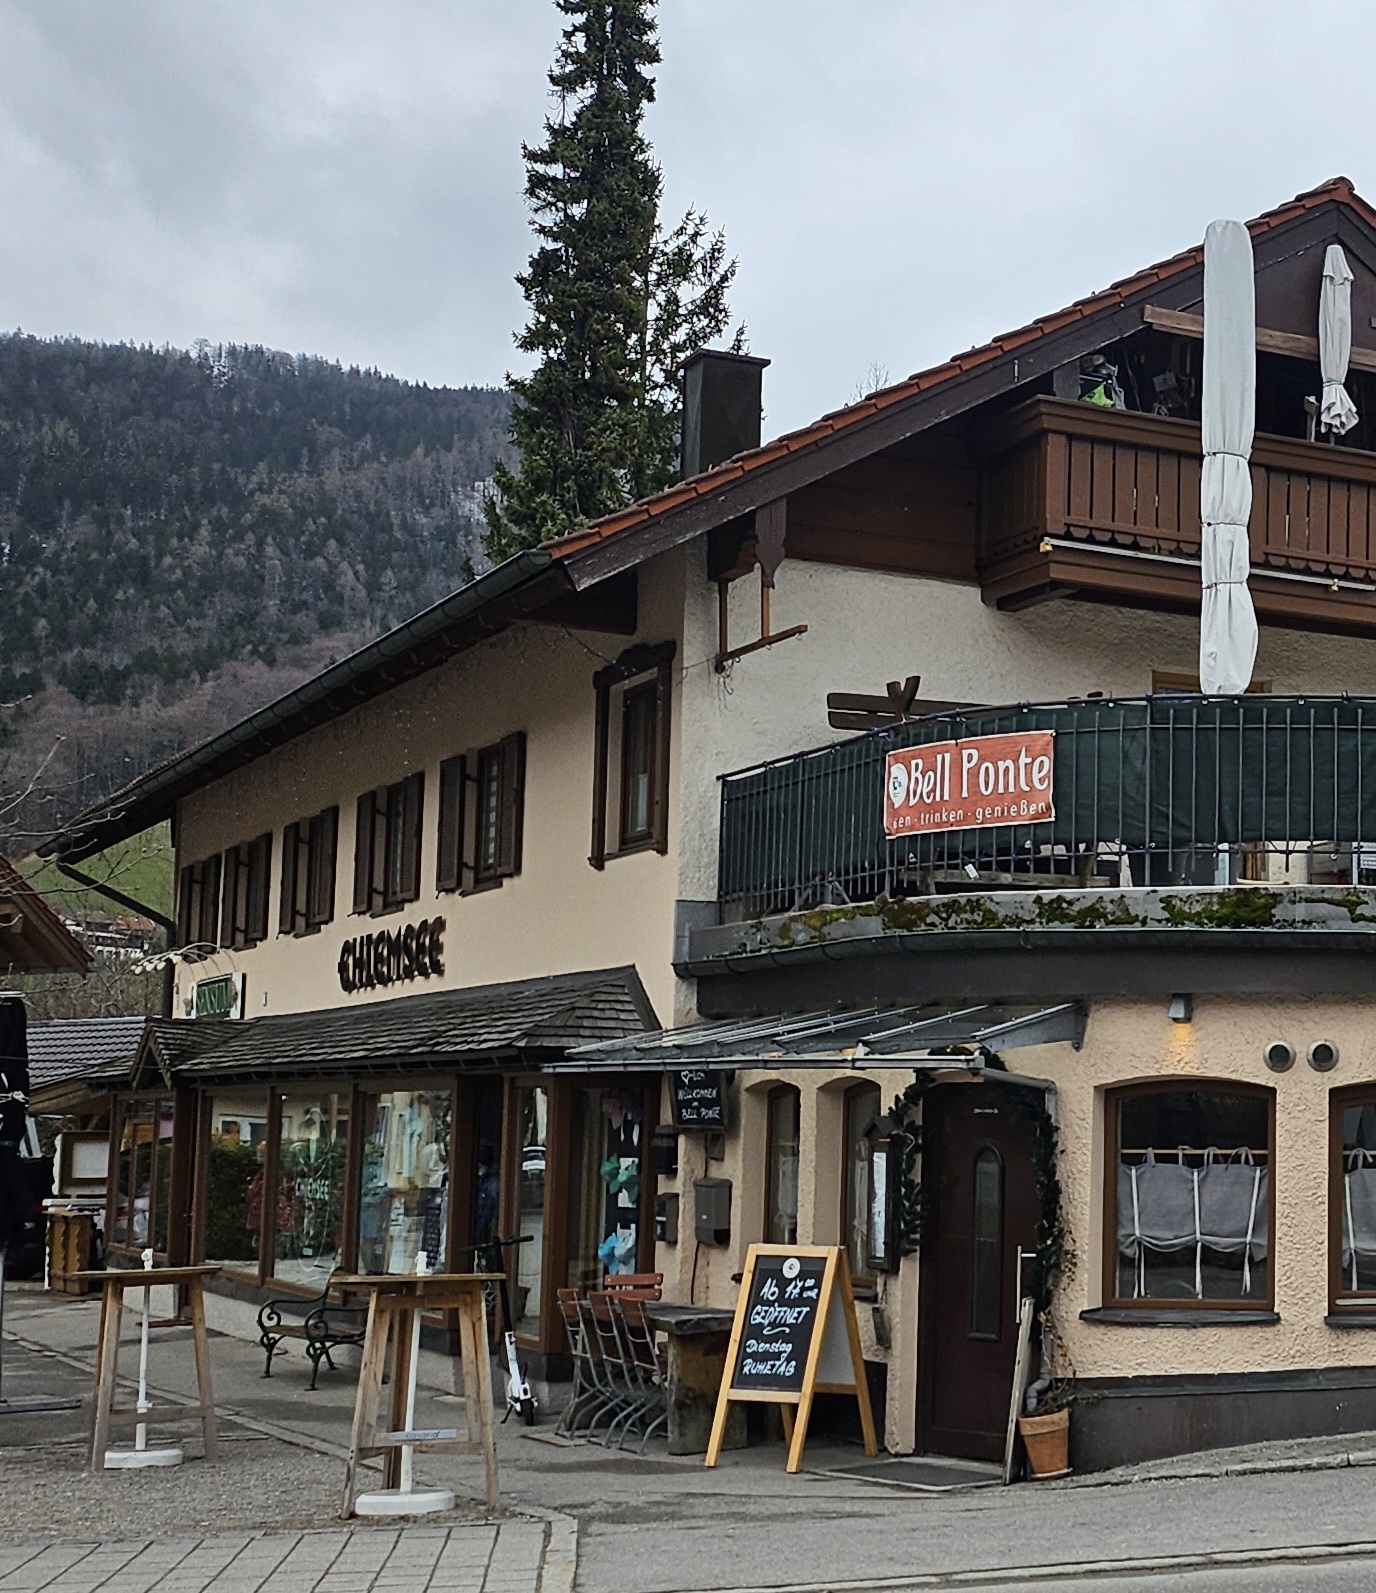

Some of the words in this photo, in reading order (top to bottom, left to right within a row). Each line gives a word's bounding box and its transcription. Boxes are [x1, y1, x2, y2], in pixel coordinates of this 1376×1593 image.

[908, 752, 951, 807] Bell
[961, 746, 1051, 798] Ponte
[920, 807, 964, 826] trinken
[975, 799, 1047, 823] genießen
[337, 915, 447, 993] CHIEMSEE
[759, 1277, 779, 1301] Ab
[750, 1302, 811, 1325] GEÖFFNET
[745, 1339, 793, 1361] Dienstag
[742, 1360, 797, 1377] RUHETAG
